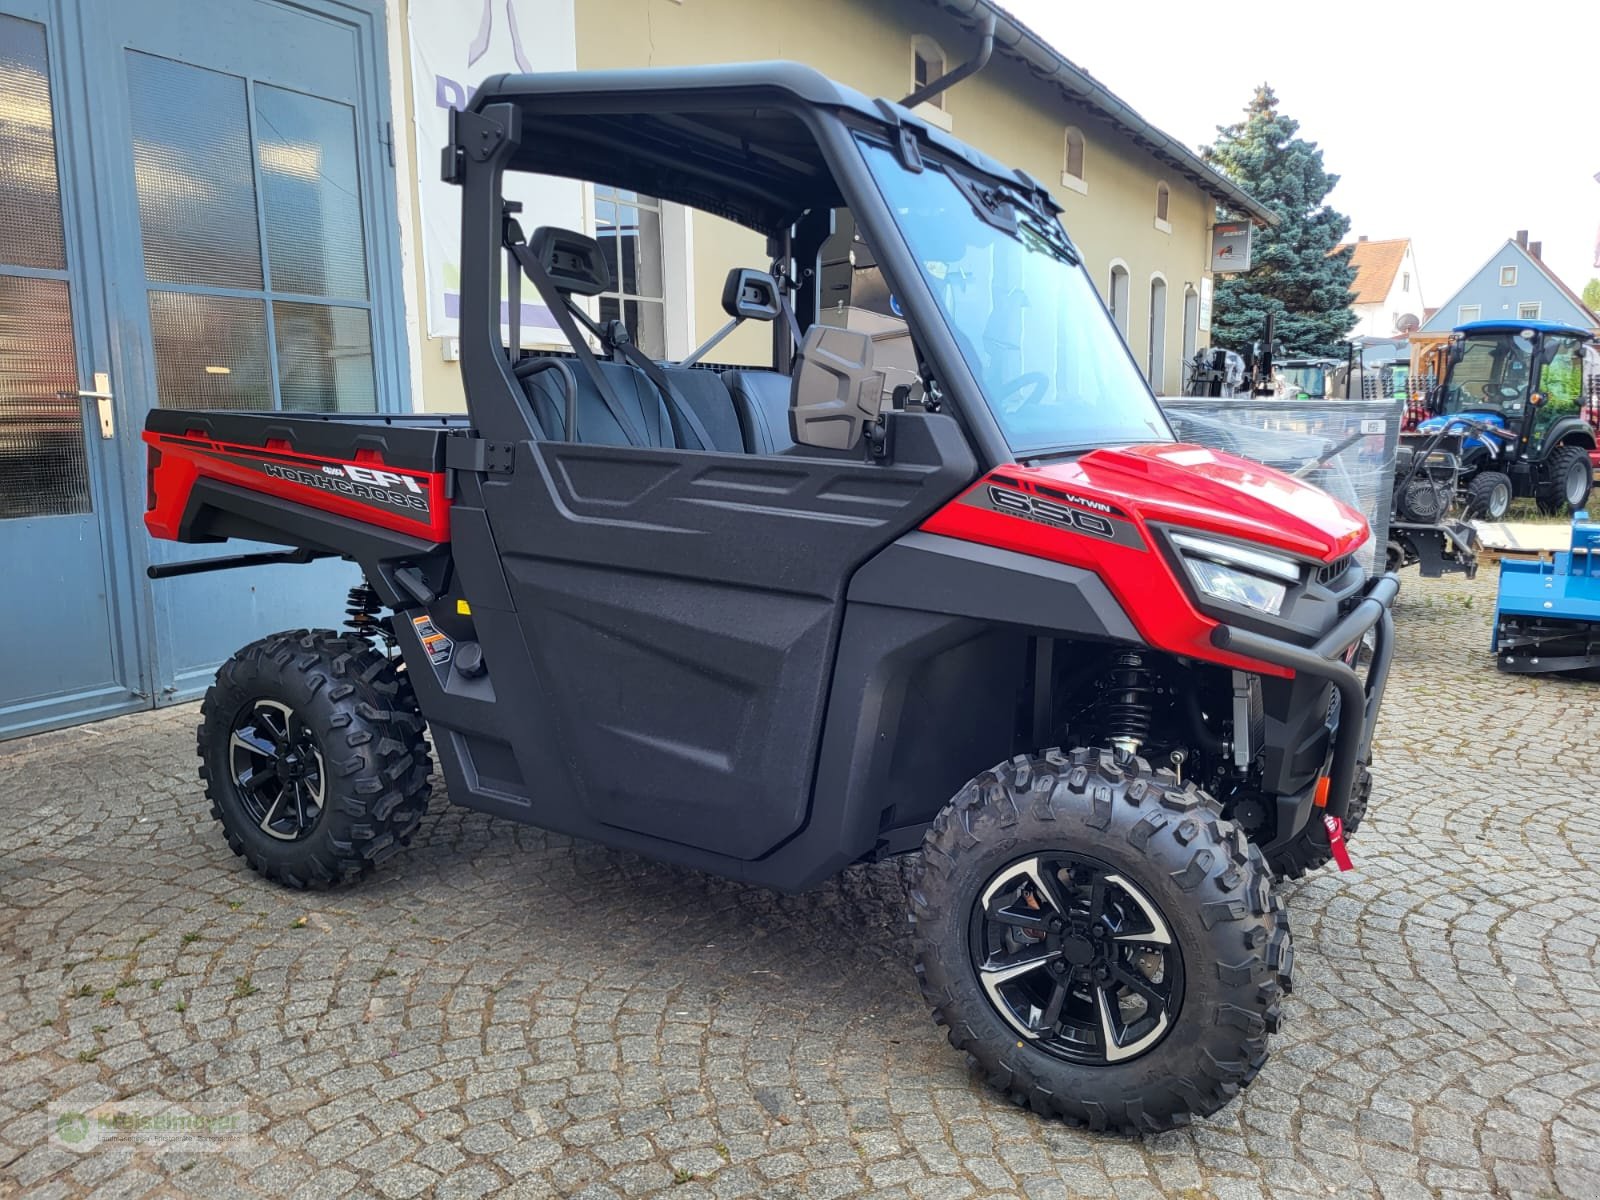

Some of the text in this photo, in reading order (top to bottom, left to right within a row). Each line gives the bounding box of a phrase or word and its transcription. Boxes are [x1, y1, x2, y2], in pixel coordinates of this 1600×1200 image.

[264, 463, 429, 512] WORKCROSS
[342, 464, 422, 494] EFI
[987, 485, 1115, 538] 650
[1066, 494, 1110, 512] V-TWIN
